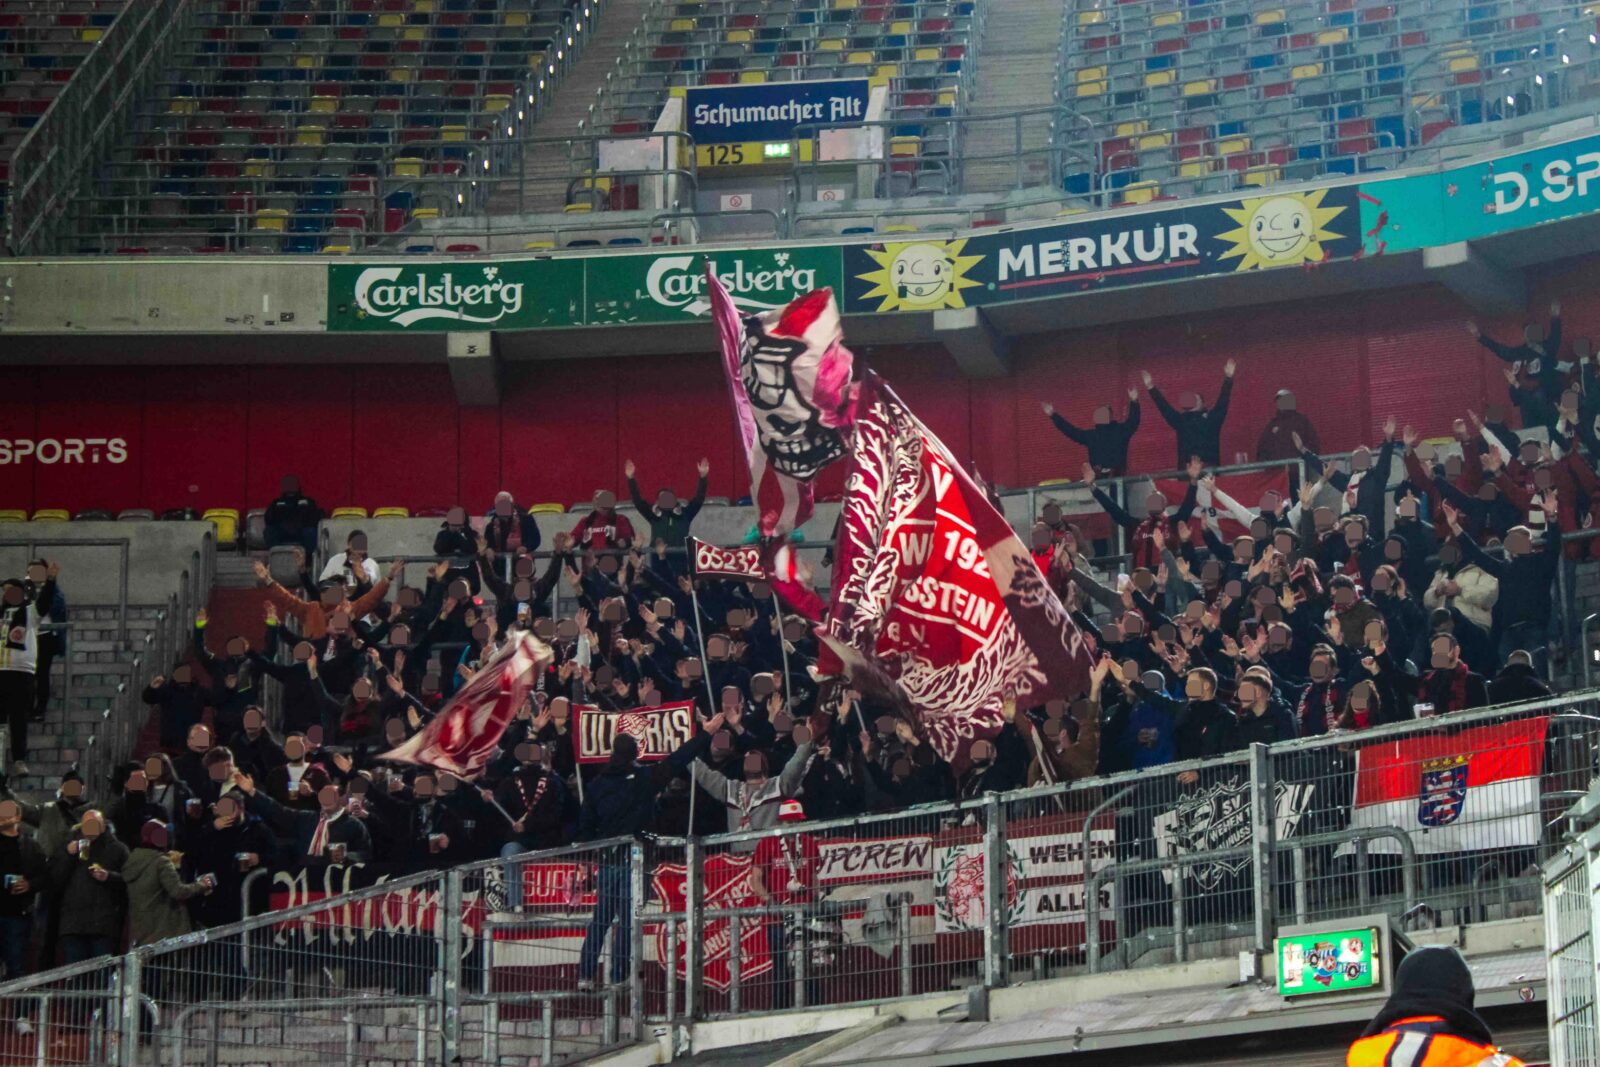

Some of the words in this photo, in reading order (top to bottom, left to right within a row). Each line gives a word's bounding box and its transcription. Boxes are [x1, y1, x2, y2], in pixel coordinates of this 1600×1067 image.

[694, 99, 824, 128] Schumacher
[828, 96, 862, 122] Alt
[707, 144, 744, 165] 125
[998, 223, 1200, 281] MERKUR
[354, 267, 524, 318] Carlsberg
[697, 545, 763, 576] 65232
[582, 709, 690, 756] ULTRAS
